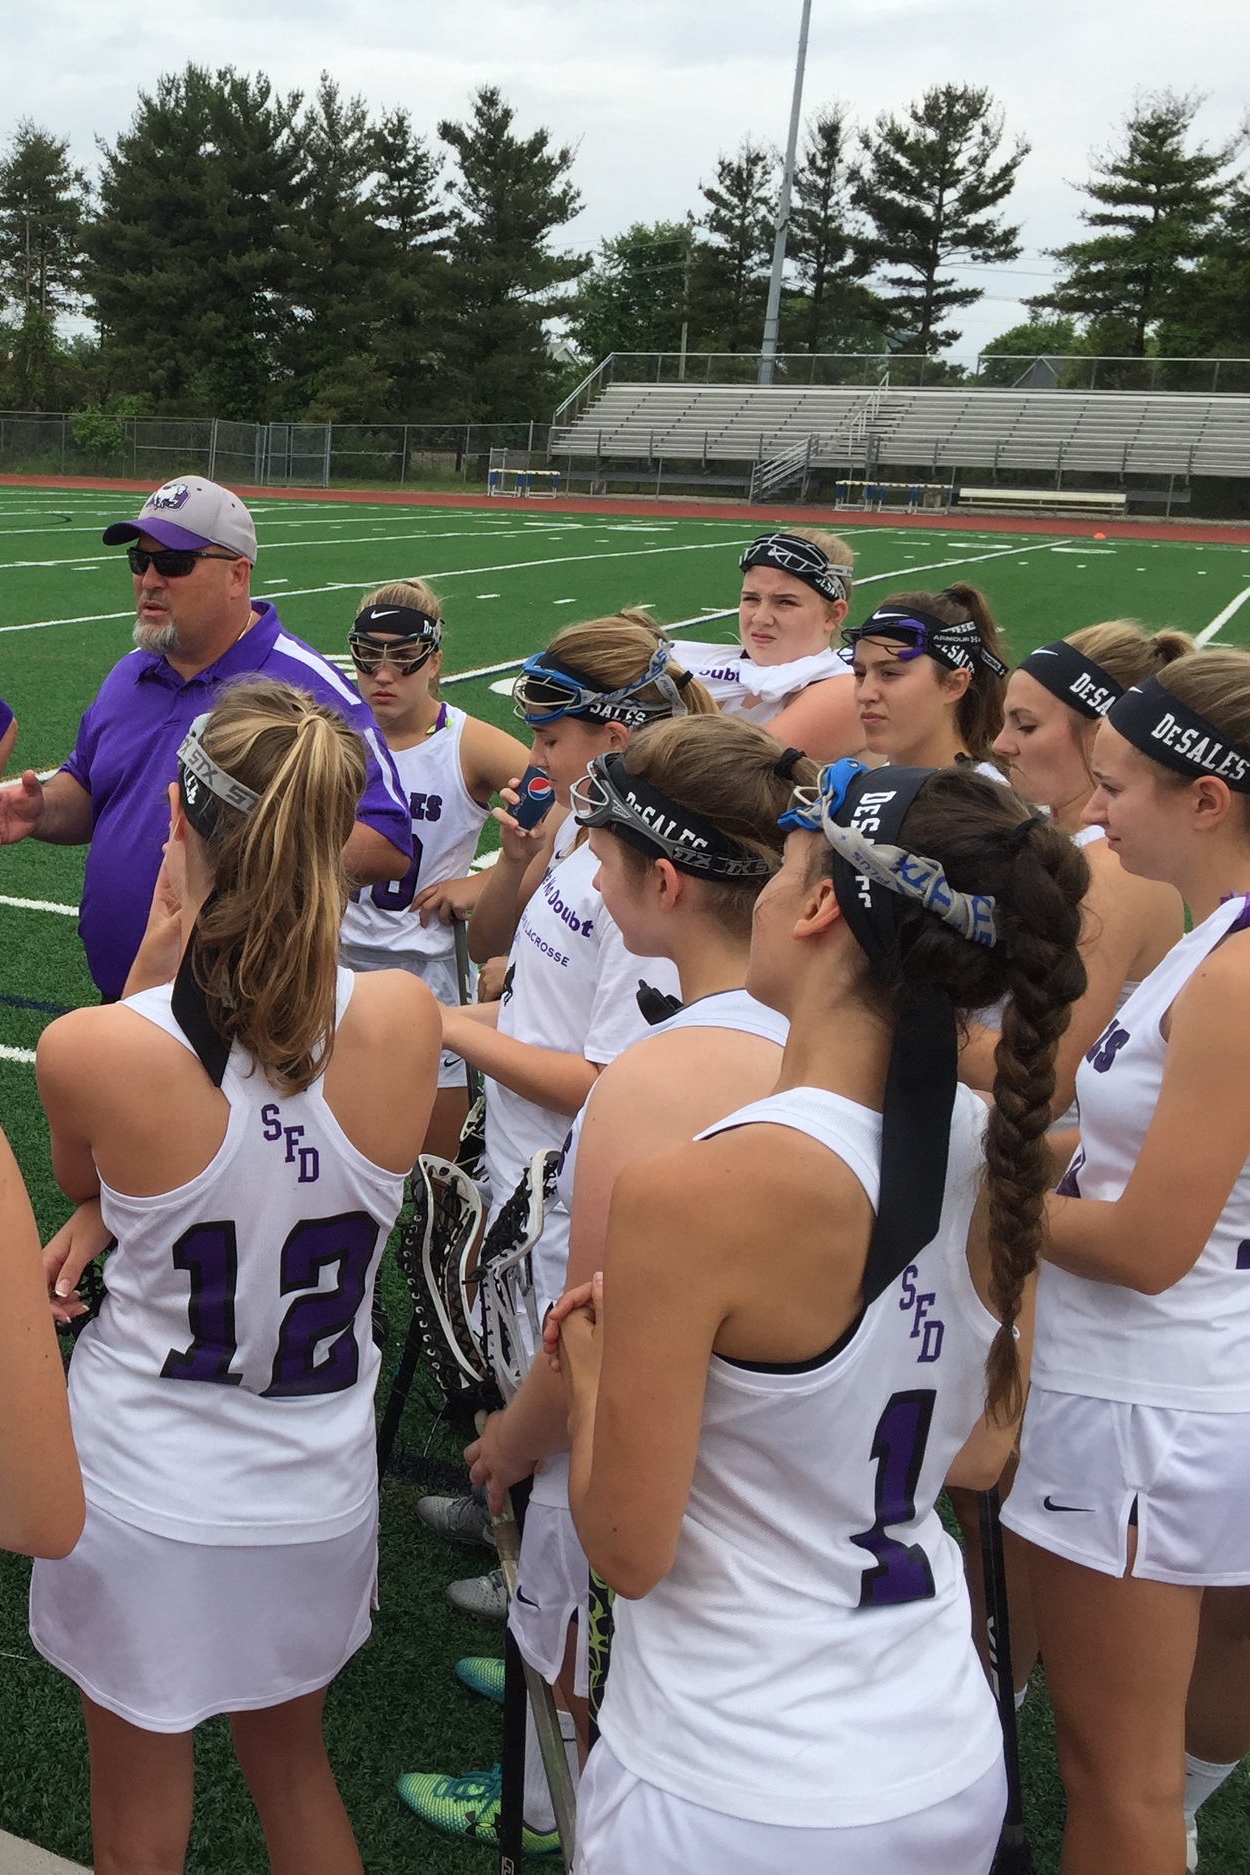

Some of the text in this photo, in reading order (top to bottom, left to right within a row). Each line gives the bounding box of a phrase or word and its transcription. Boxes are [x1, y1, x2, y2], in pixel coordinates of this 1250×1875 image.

[933, 635, 970, 643] ARMOUR
[589, 703, 647, 725] SALES
[188, 749, 219, 786] STX
[547, 889, 594, 938] Doubt
[524, 920, 570, 968] LACROSSE
[261, 1103, 319, 1183] SFD
[160, 1210, 380, 1397] 12
[899, 1264, 945, 1362] SFD
[849, 1389, 937, 1607] 1
